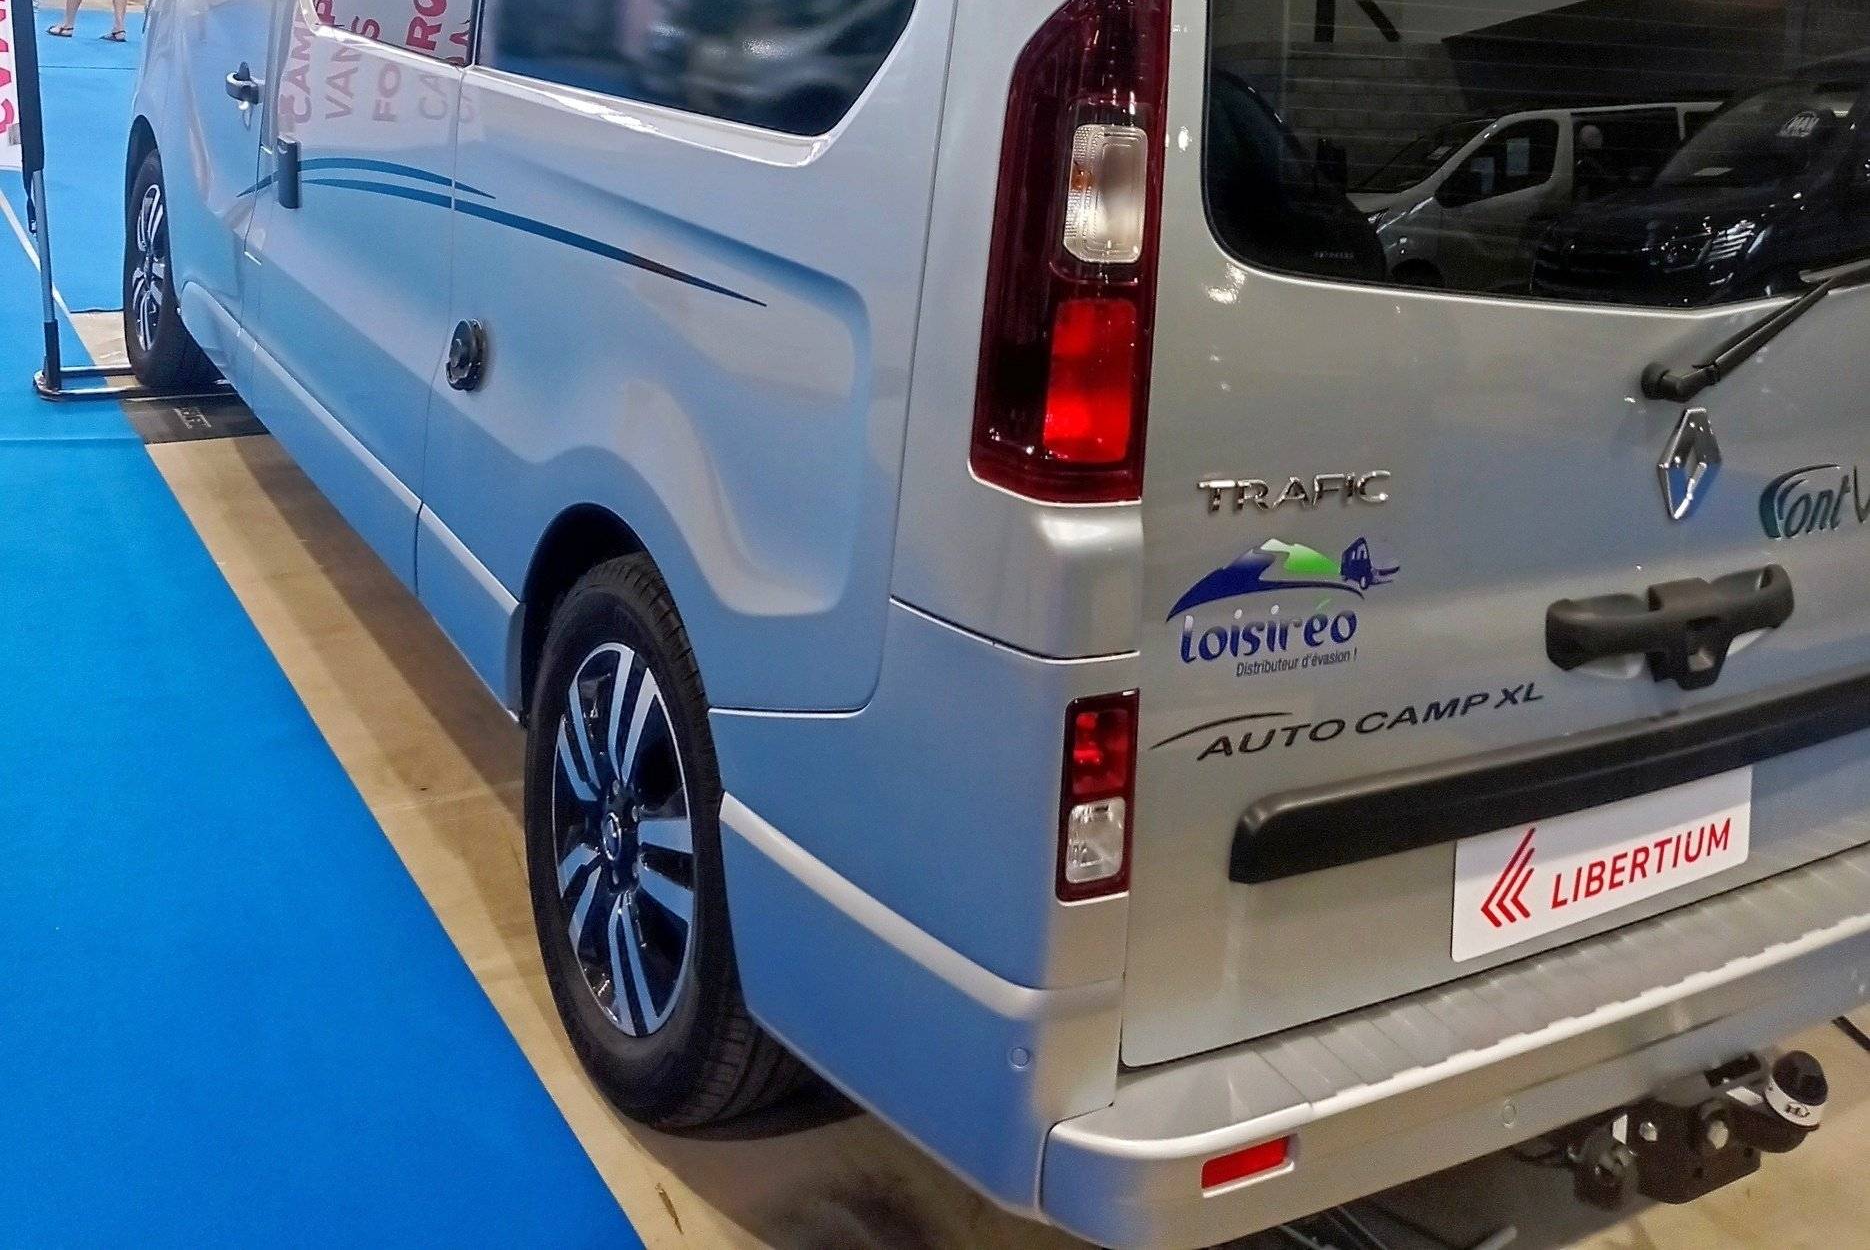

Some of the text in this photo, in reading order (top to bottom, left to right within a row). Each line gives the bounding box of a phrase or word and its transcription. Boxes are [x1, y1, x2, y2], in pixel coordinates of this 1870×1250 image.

[1198, 469, 1391, 511] TRAFIC
[1236, 658, 1298, 677] Distributeur
[1302, 650, 1350, 668] d'évasion
[1551, 817, 1731, 909] LIBERTIUM
